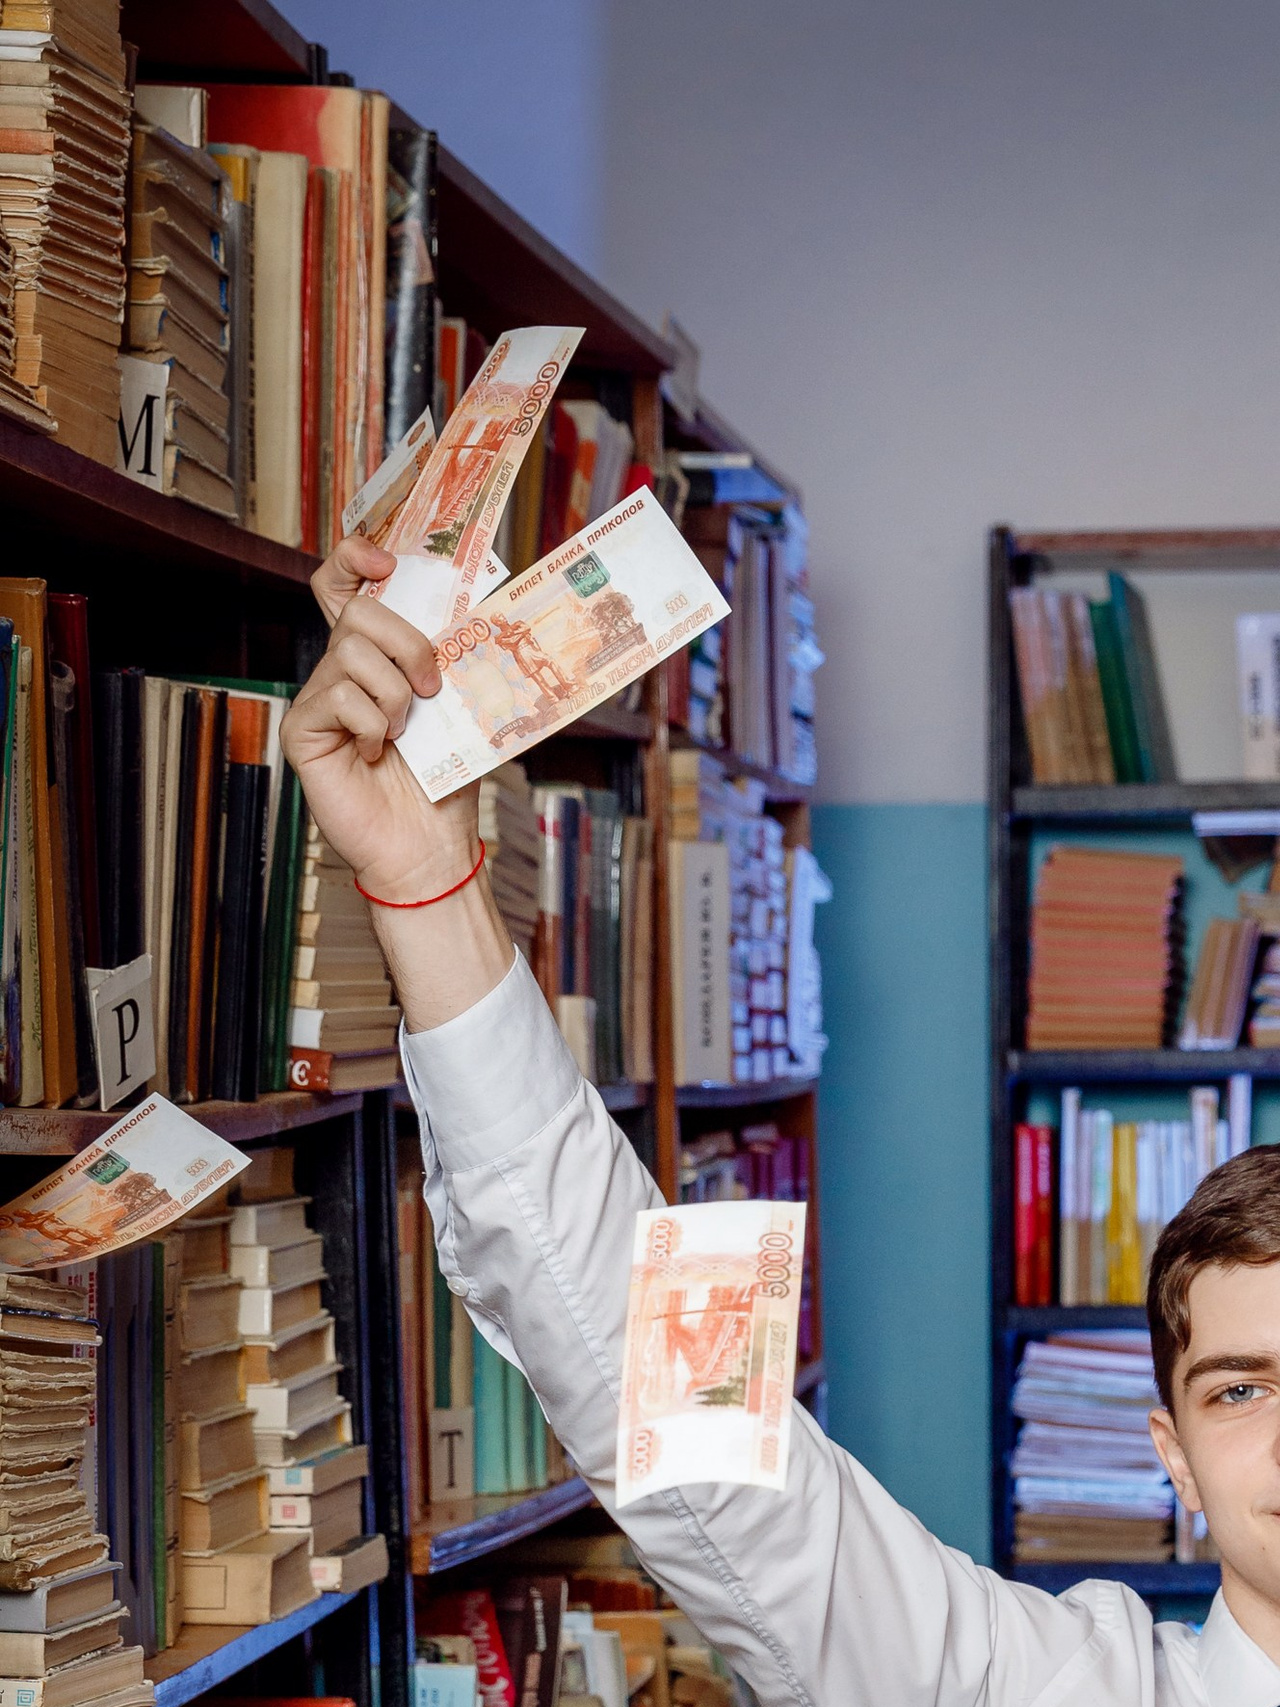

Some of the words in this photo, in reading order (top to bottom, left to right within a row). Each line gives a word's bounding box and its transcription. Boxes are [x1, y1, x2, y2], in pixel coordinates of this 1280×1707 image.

[479, 339, 510, 385] 5000
[511, 360, 560, 438] 5000
[452, 591, 470, 622] ЯТЬ
[461, 527, 489, 585] ТЫСЯЧ
[484, 460, 515, 527] ДУБЛЕЙ
[508, 570, 544, 602] БИЛЕТ
[547, 542, 585, 574] БАНКА
[586, 499, 645, 546] ПРИКОЛОВ
[665, 593, 688, 617] 5000
[566, 681, 606, 714] ПЯТЬ
[608, 645, 656, 685] ТЫСЯЧ
[655, 602, 714, 653] ДУБЛЕЙ
[112, 997, 140, 1087] Р
[31, 1174, 65, 1201] БИЛЕТ
[67, 1147, 104, 1176] БАНКА
[103, 1102, 158, 1148] ПРИКОЛОВ
[185, 1158, 209, 1177] 5000
[652, 1218, 675, 1260] 5000
[757, 1231, 793, 1299] 5000
[438, 1428, 464, 1488] Т
